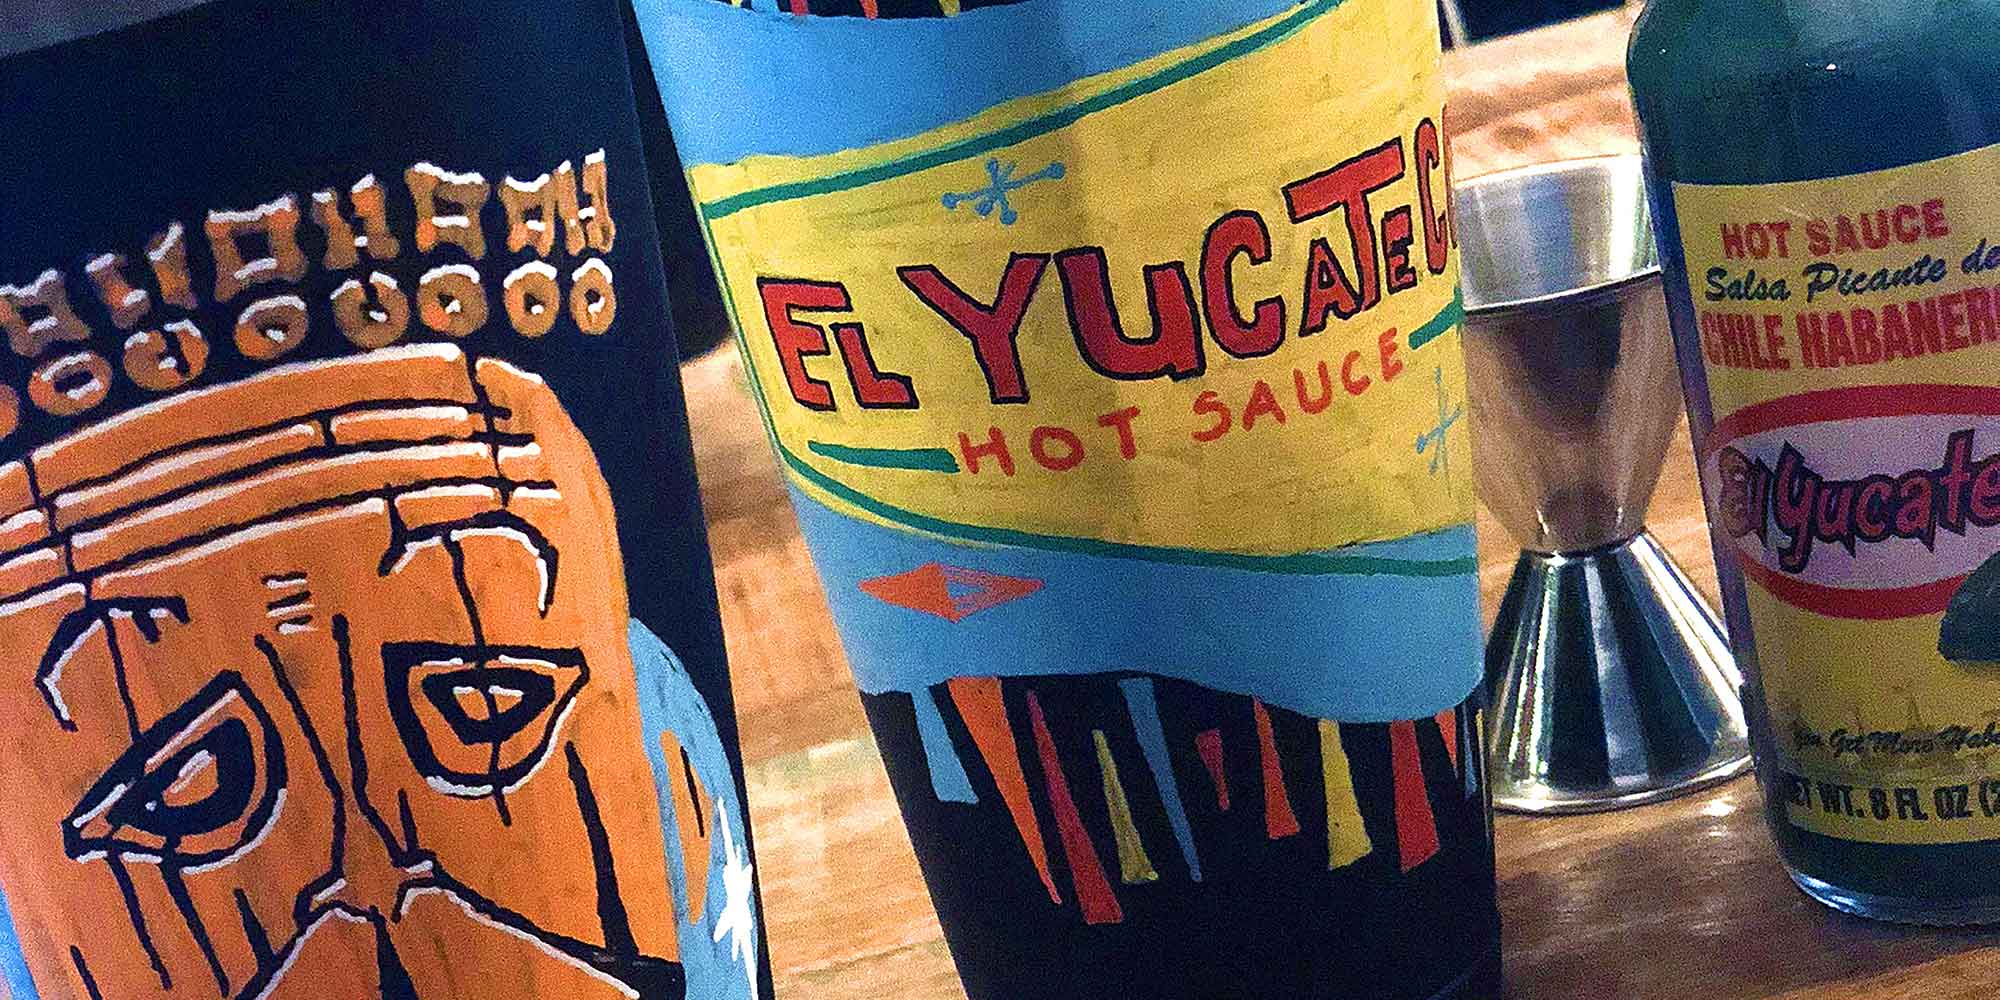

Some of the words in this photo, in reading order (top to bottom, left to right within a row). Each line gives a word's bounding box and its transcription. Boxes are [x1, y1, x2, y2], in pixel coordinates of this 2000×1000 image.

[1719, 222, 1791, 260] HOT
[1805, 199, 1948, 256] SAUCE
[1704, 266, 1791, 302] Salsa
[1805, 255, 1947, 302] Picante
[1961, 238, 2000, 274] de
[757, 277, 919, 412] EL
[1701, 311, 1790, 371] CHILE
[1797, 287, 2000, 369] HABANER
[957, 407, 1142, 478] HOT
[1191, 327, 1405, 443] SAUCE
[1869, 786, 1890, 821] 8
[1933, 783, 1973, 821] OZ
